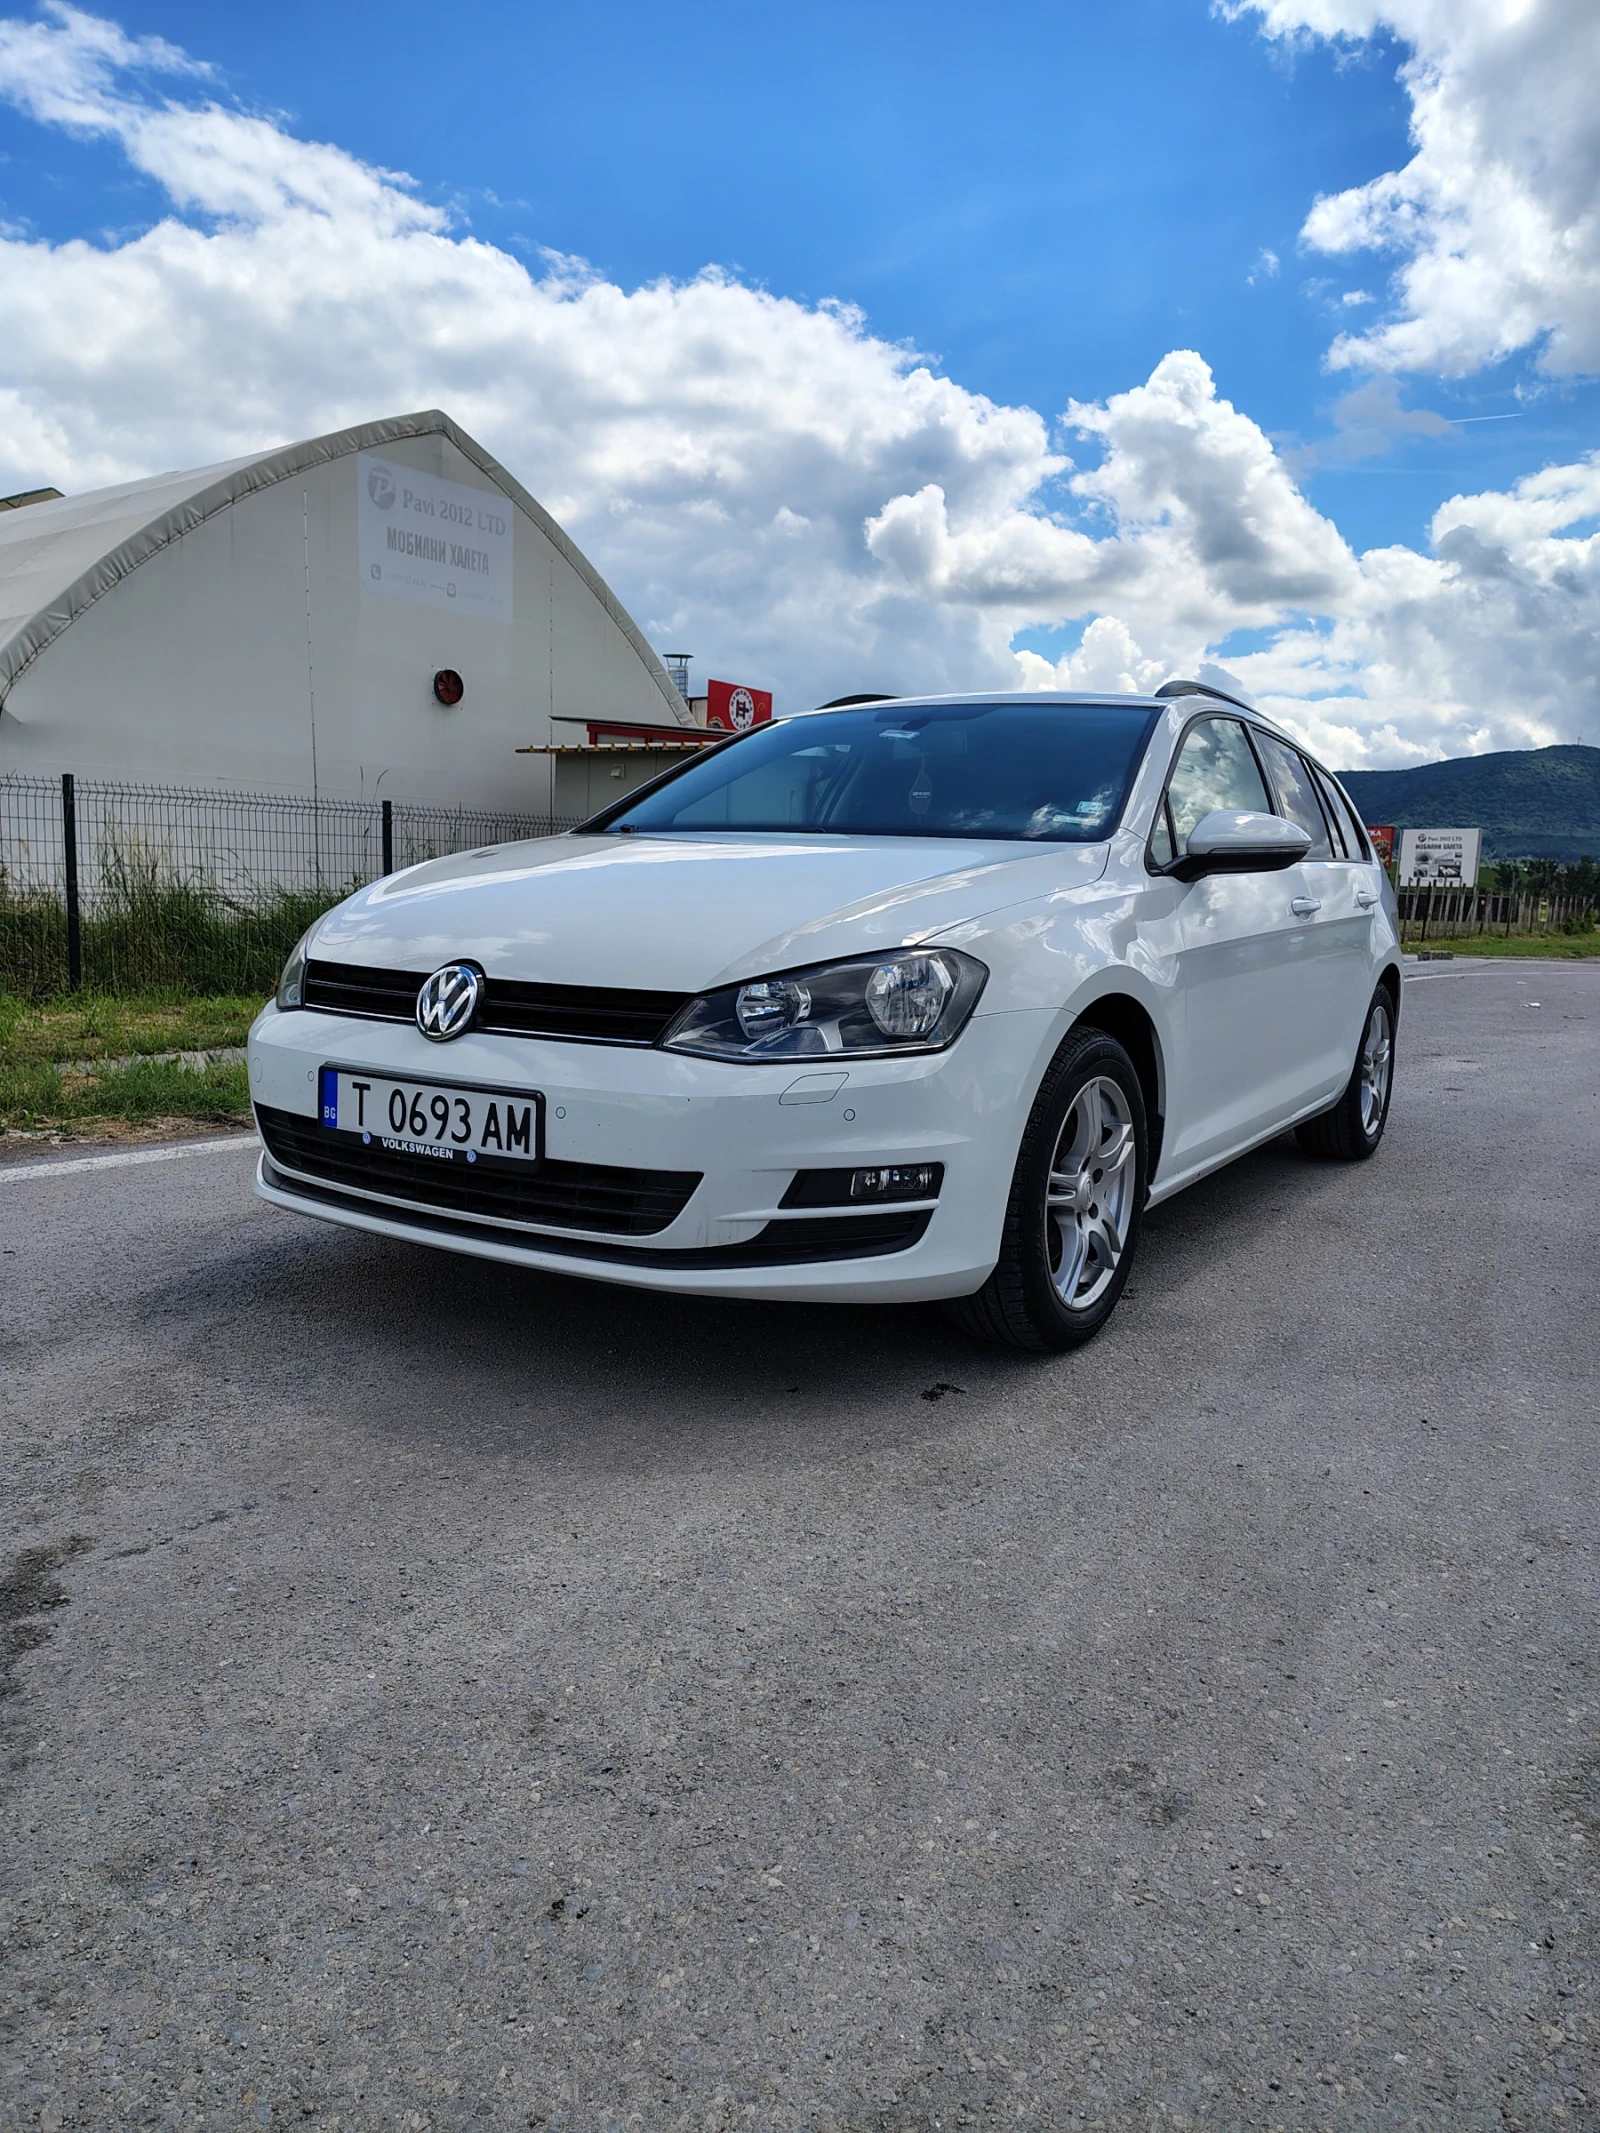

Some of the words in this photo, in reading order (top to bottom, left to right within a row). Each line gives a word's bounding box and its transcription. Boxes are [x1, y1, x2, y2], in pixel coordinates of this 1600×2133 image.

[402, 488, 435, 517] Pavi
[439, 499, 473, 527] 2012
[477, 510, 506, 536] LTD
[386, 526, 447, 564] МОБИЛНИ
[449, 543, 490, 575] ХАЛЕТА
[323, 1105, 337, 1120] BG
[352, 1081, 371, 1127] T
[388, 1088, 472, 1144] 0693
[481, 1102, 531, 1154] AM
[381, 1137, 454, 1160] VOLKSWAGEN
